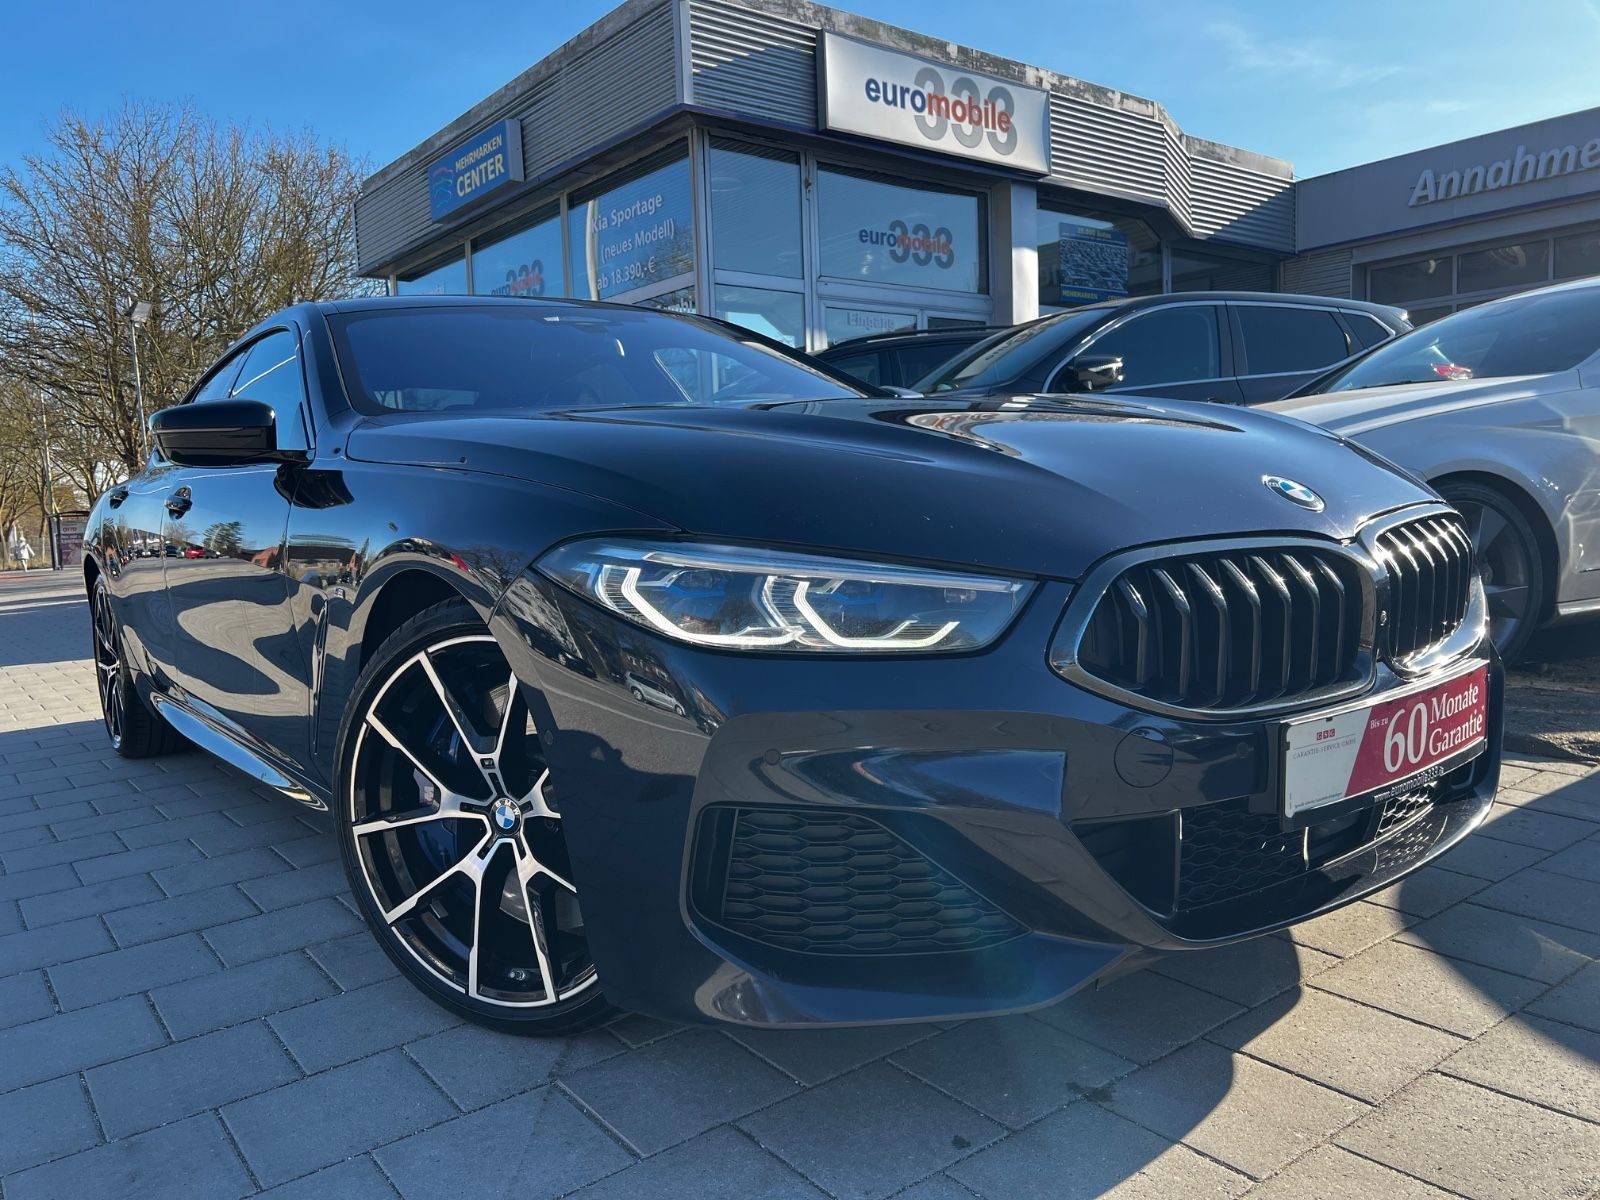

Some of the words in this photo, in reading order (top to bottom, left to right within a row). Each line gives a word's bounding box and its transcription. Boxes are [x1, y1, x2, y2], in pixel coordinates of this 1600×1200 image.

[865, 78, 1012, 133] euromobile
[914, 66, 1018, 156] 333
[455, 134, 502, 172] MEHRMARKEN
[456, 153, 505, 197] CENTER
[1408, 138, 1600, 208] Annahme
[591, 215, 608, 233] Kia
[611, 194, 663, 227] Sportage
[601, 239, 632, 264] (neues
[634, 218, 675, 248] Modell)
[858, 229, 950, 255] euromobile
[889, 219, 954, 269] 333
[597, 277, 609, 290] ab
[1370, 719, 1380, 730] Bis
[1383, 702, 1428, 773] 60
[1430, 683, 1479, 725] Monate
[495, 799, 520, 815] BMW
